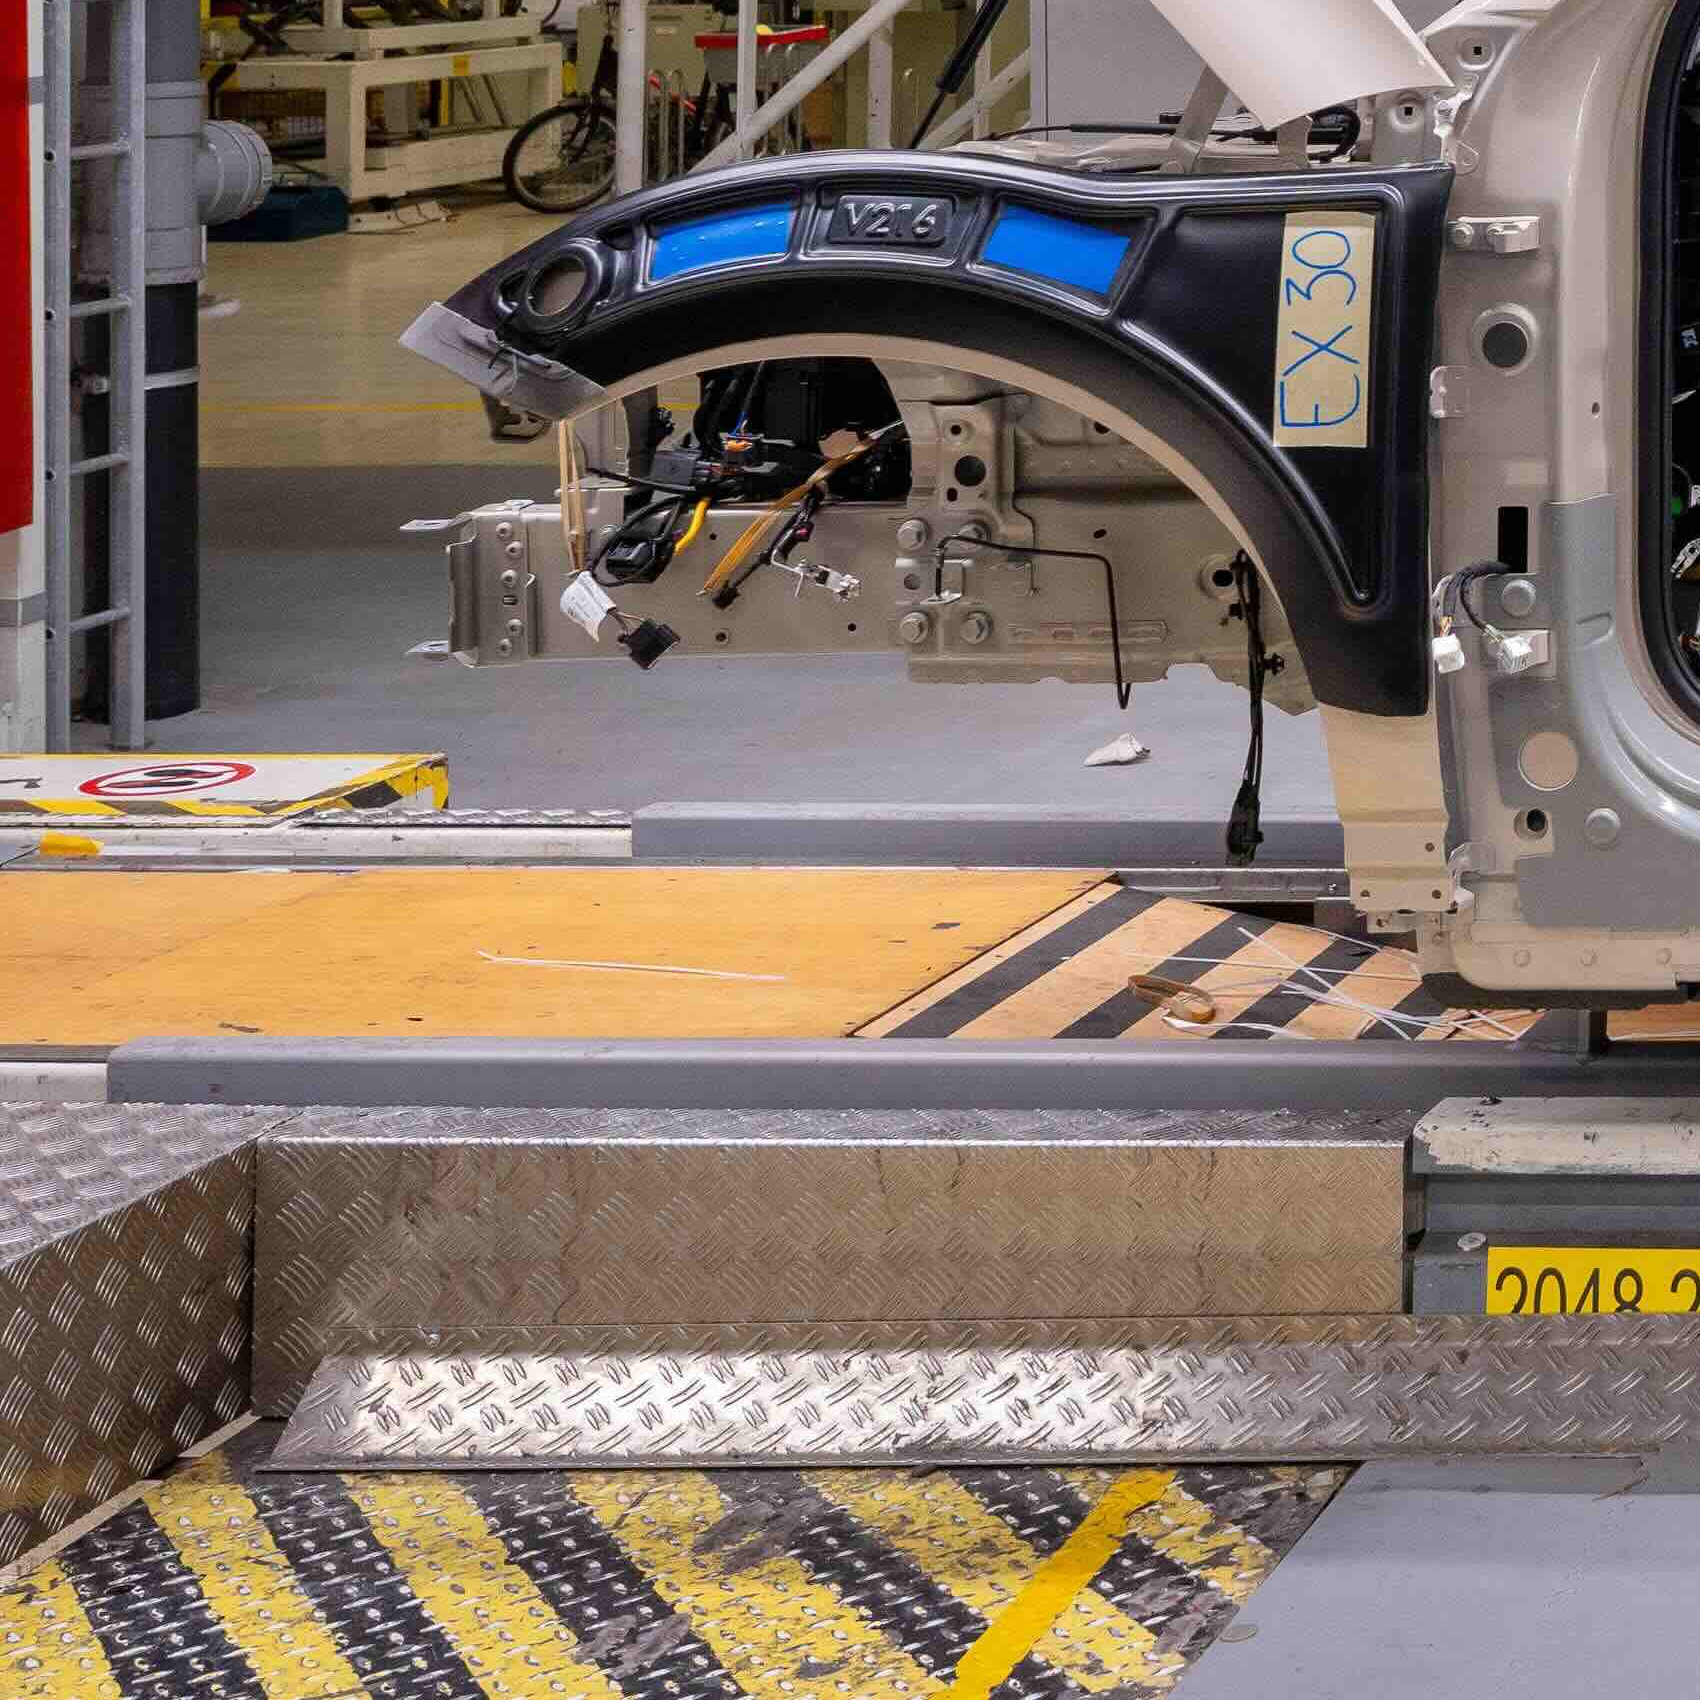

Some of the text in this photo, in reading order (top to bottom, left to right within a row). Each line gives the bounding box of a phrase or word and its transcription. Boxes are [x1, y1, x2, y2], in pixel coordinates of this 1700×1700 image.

[844, 202, 938, 239] V216
[1279, 230, 1361, 428] EX 30
